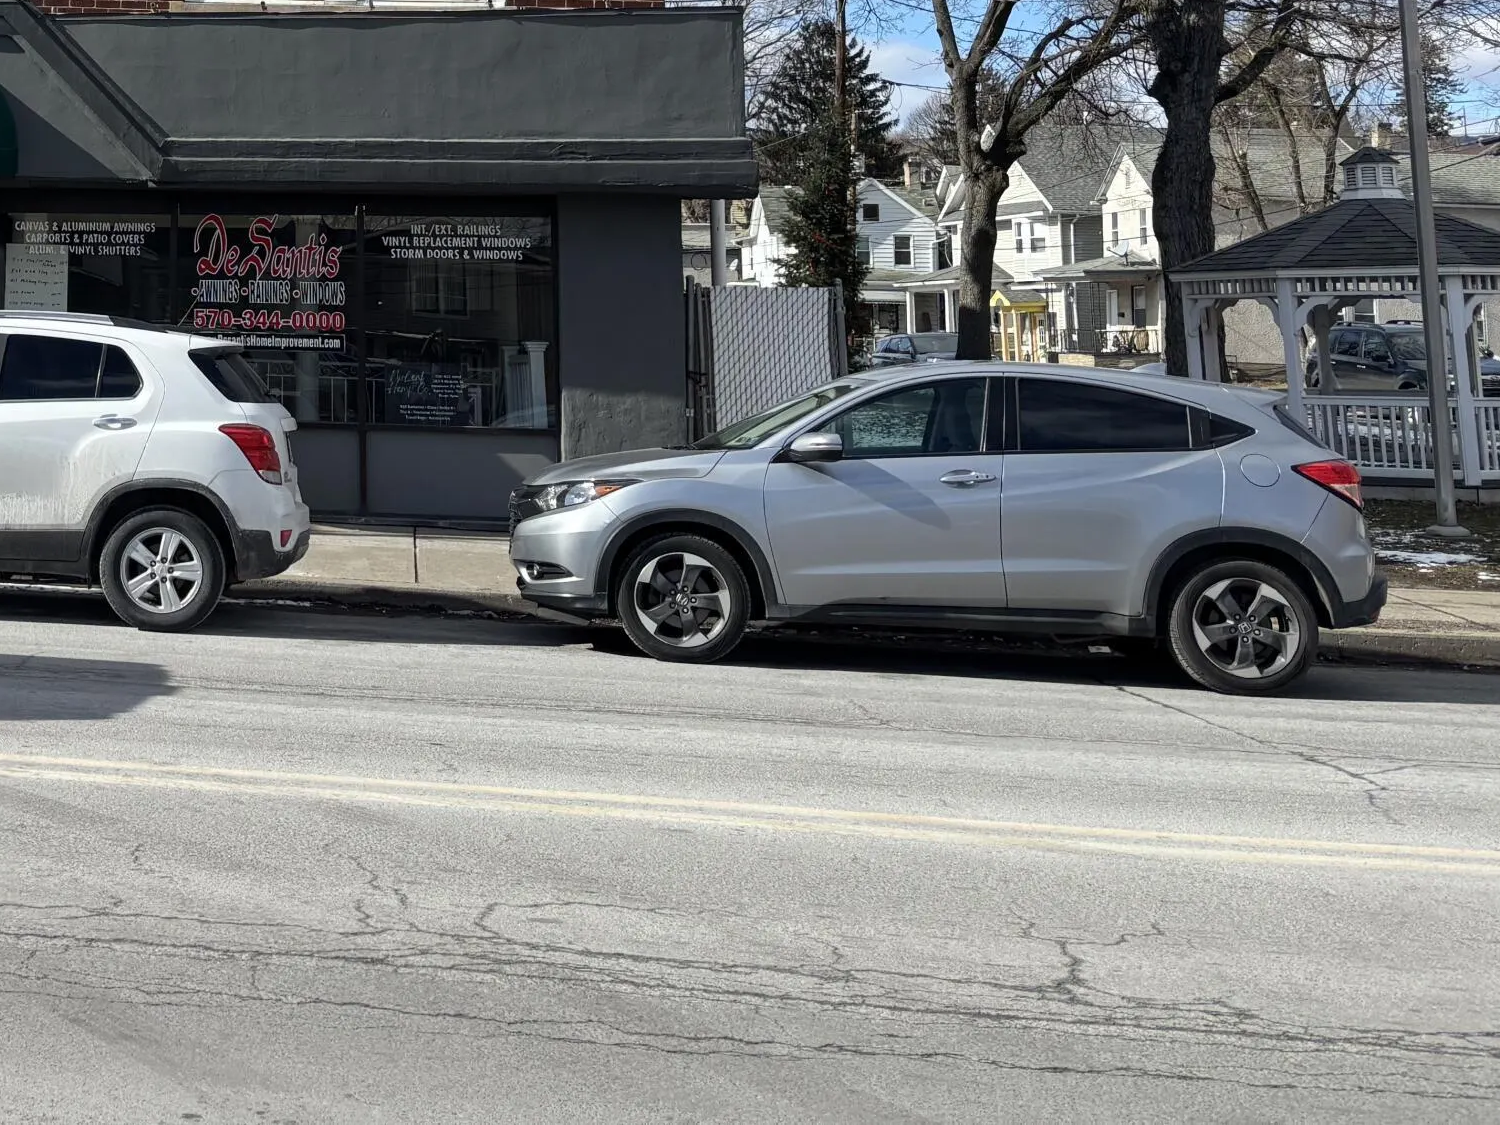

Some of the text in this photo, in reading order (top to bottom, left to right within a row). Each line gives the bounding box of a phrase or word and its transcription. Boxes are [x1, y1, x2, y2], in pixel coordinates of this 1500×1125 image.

[14, 221, 156, 233] CANVAS & ALUMINUM AWNINGS
[457, 225, 501, 236] RAILINGS
[25, 233, 145, 244] CARPORTS & PATIO COVERS
[382, 236, 531, 249] VINYL REPLACEMENT WINDOWS
[69, 245, 95, 255] VINYL
[98, 245, 141, 256] SHUTTERS
[390, 248, 523, 261] STORM DOORS & WINDOWS
[300, 281, 345, 306] WINDOWS
[194, 308, 345, 331] 570-344-0000
